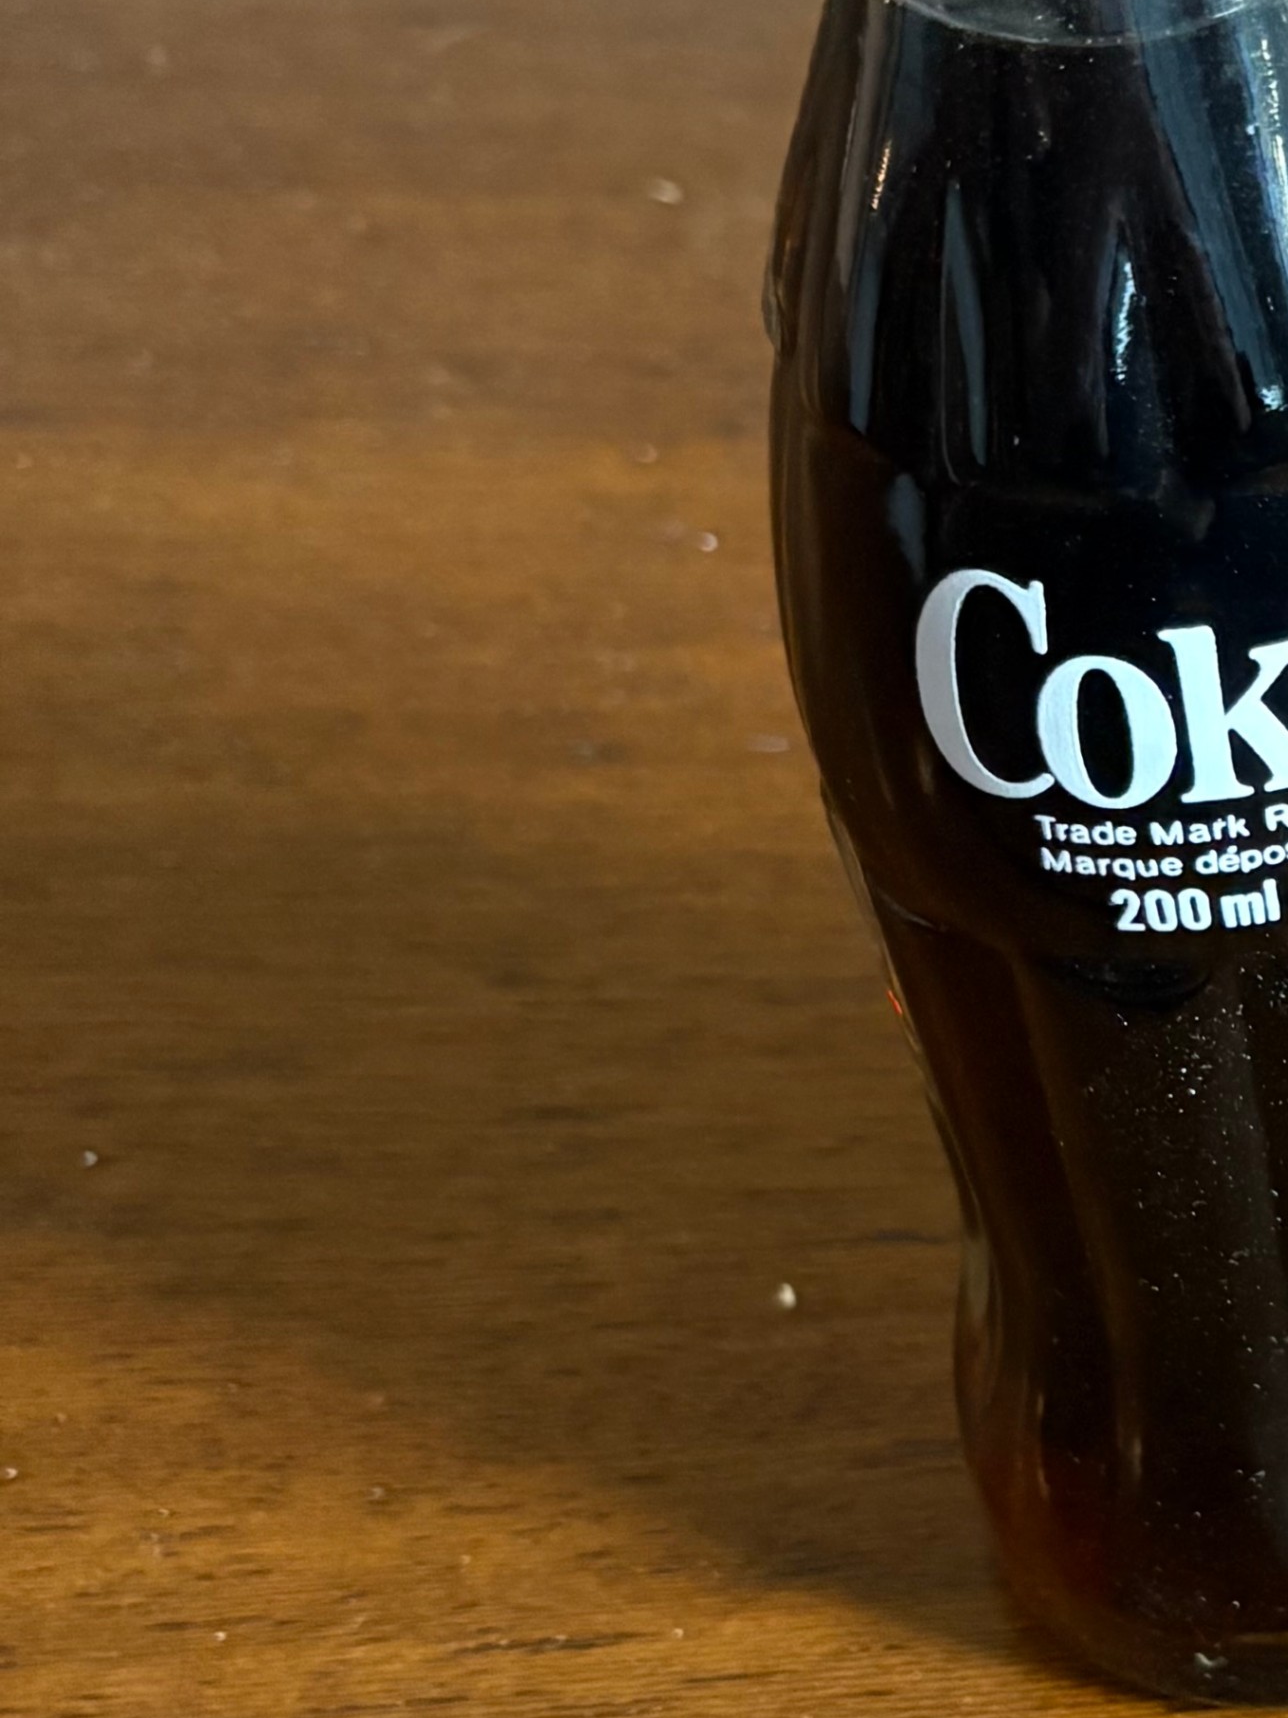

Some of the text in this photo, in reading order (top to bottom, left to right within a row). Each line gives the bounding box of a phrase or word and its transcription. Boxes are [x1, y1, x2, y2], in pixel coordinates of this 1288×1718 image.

[1034, 814, 1138, 846] Trade
[1149, 813, 1251, 846] Mark
[1039, 846, 1184, 881] Marque
[1108, 878, 1282, 933] 200 ml
